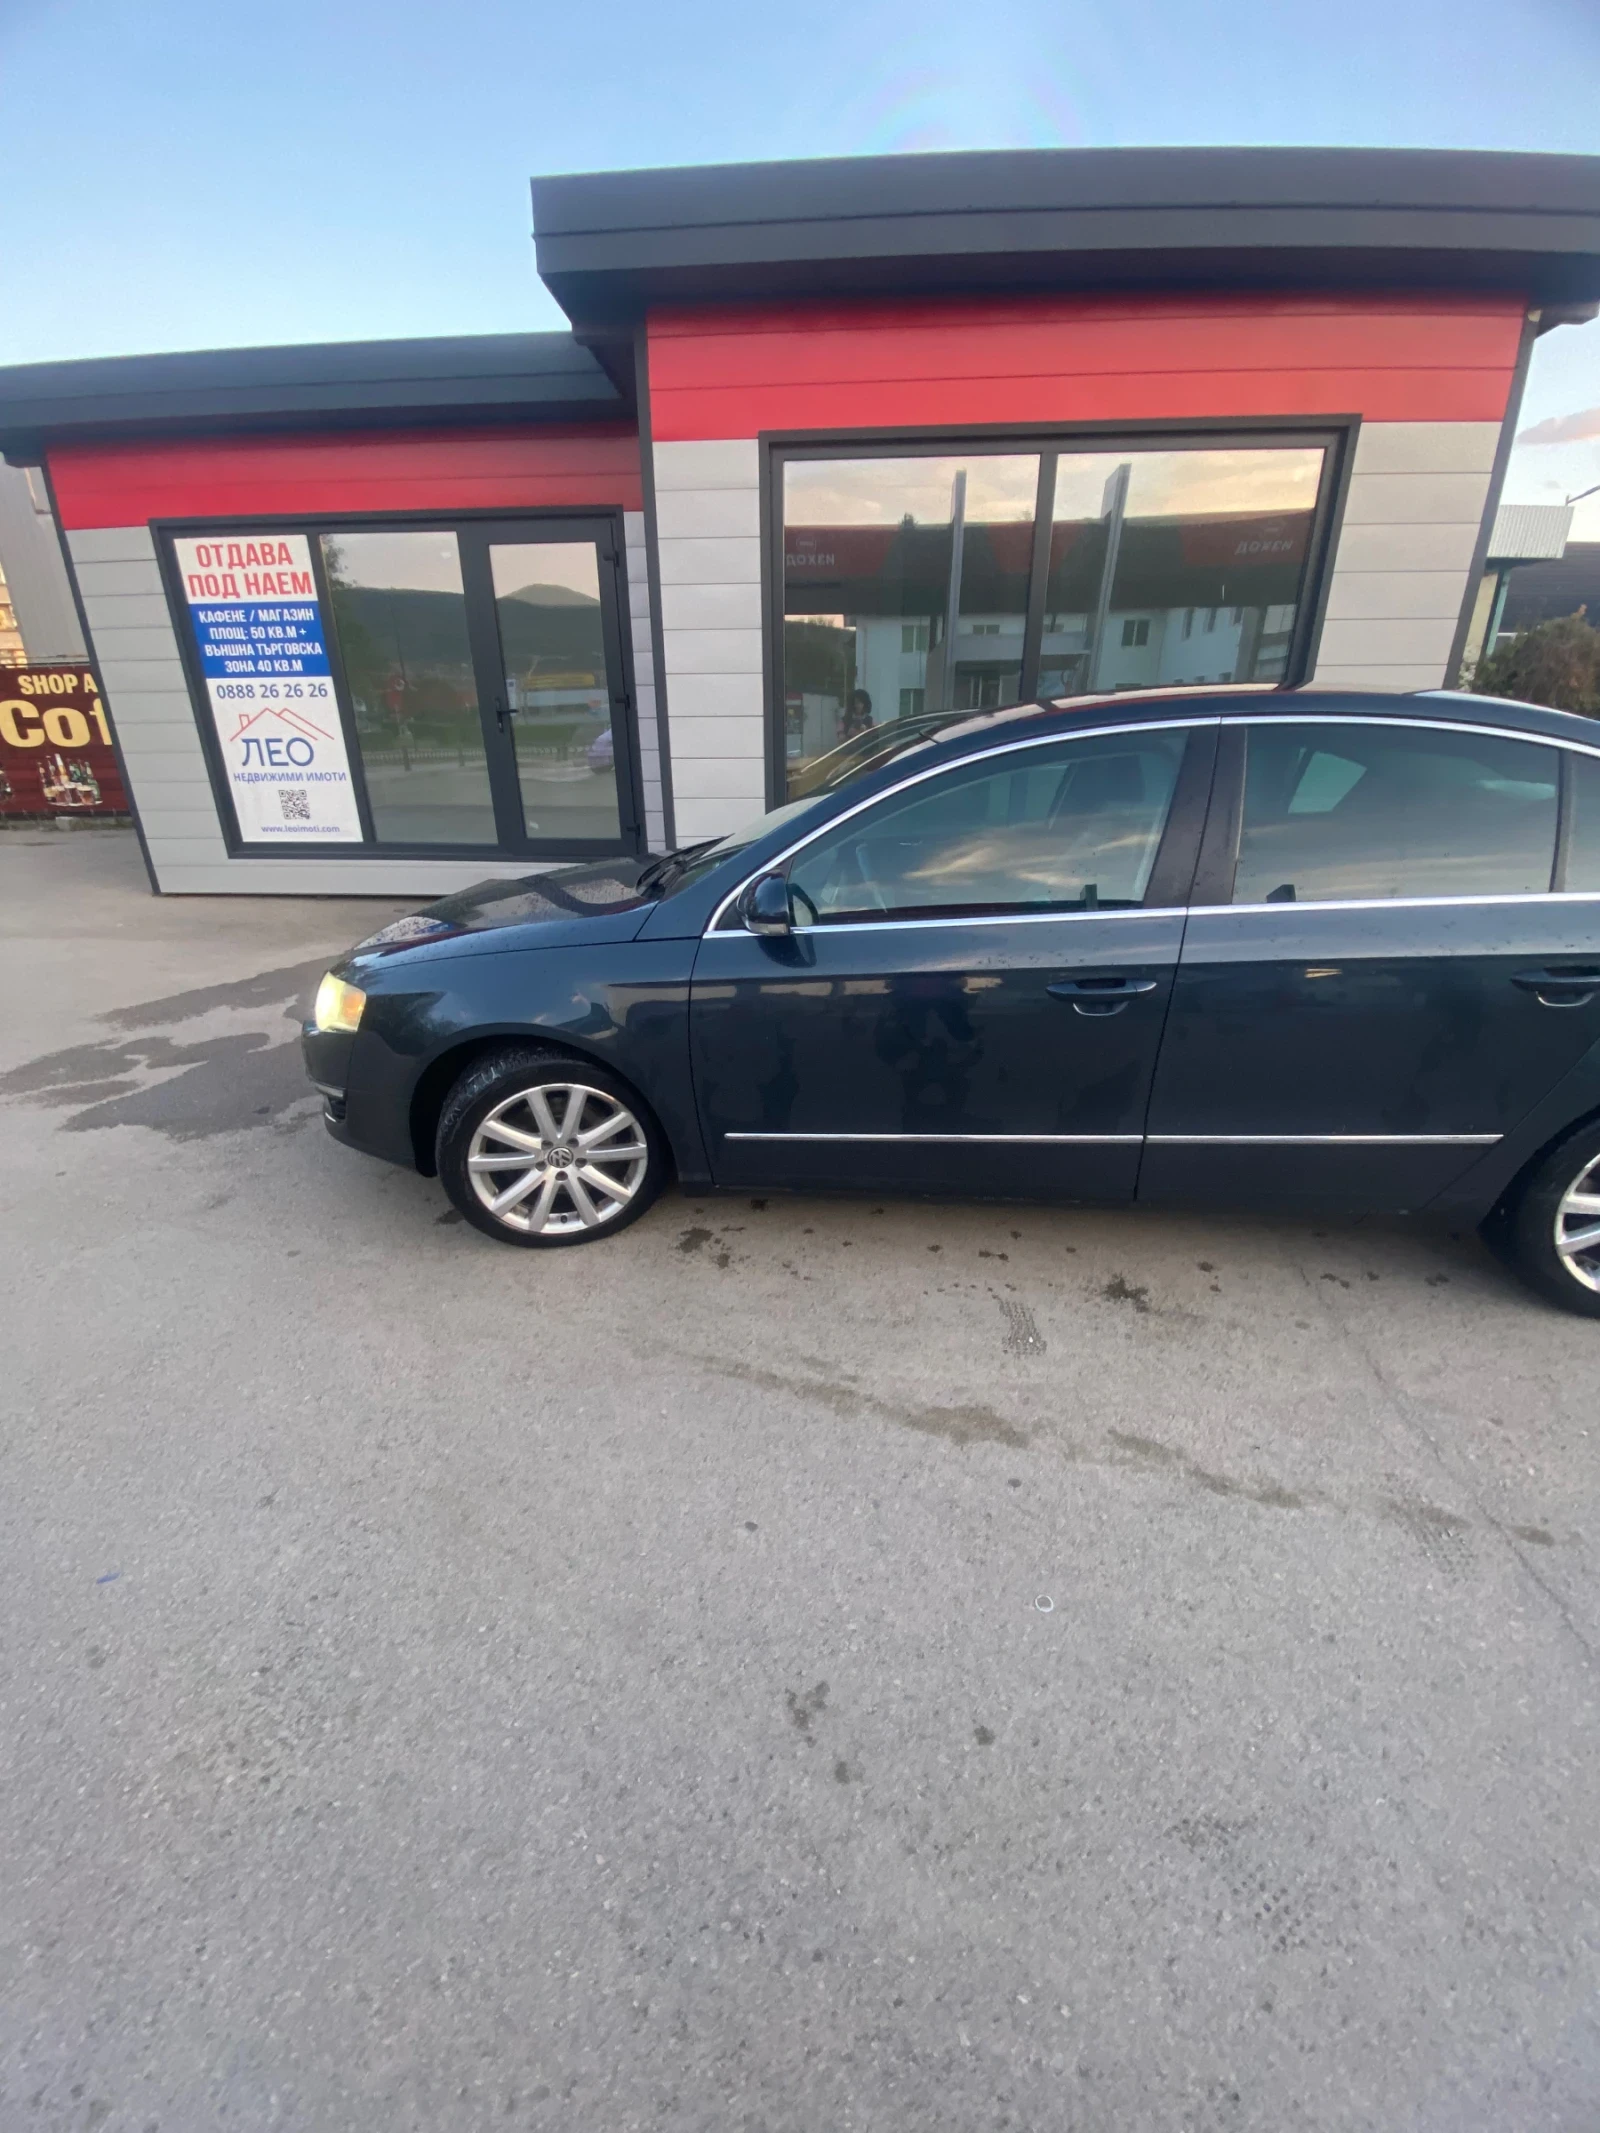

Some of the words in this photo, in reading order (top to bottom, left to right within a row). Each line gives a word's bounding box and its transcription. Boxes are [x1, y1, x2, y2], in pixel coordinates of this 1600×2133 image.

[195, 542, 294, 570] ОТДАВА
[187, 573, 241, 599] ПОД
[243, 571, 313, 596] НАЕМ
[198, 609, 247, 623] КАФЕНЕ
[257, 608, 315, 621] МАГАЗИН
[209, 627, 249, 640] ПЛОЩ:
[250, 627, 266, 640] 50
[267, 625, 298, 638] КВ.М
[204, 644, 255, 657] ВЪНШНА
[256, 642, 323, 656] ТЪРГОВСКА
[224, 661, 256, 673] ЗОНА
[257, 661, 271, 672] 40
[273, 659, 304, 672] КВ.М
[17, 674, 79, 695] SHOP
[216, 684, 256, 699] 0888
[259, 683, 280, 699] 26
[283, 683, 304, 698] 26
[307, 683, 328, 698] 26
[241, 736, 315, 767] ЛЕО
[233, 772, 304, 784] НЕДВИЖИМИ
[306, 772, 347, 782] ИМОТИ
[261, 825, 340, 833] www.leoimoti.com
